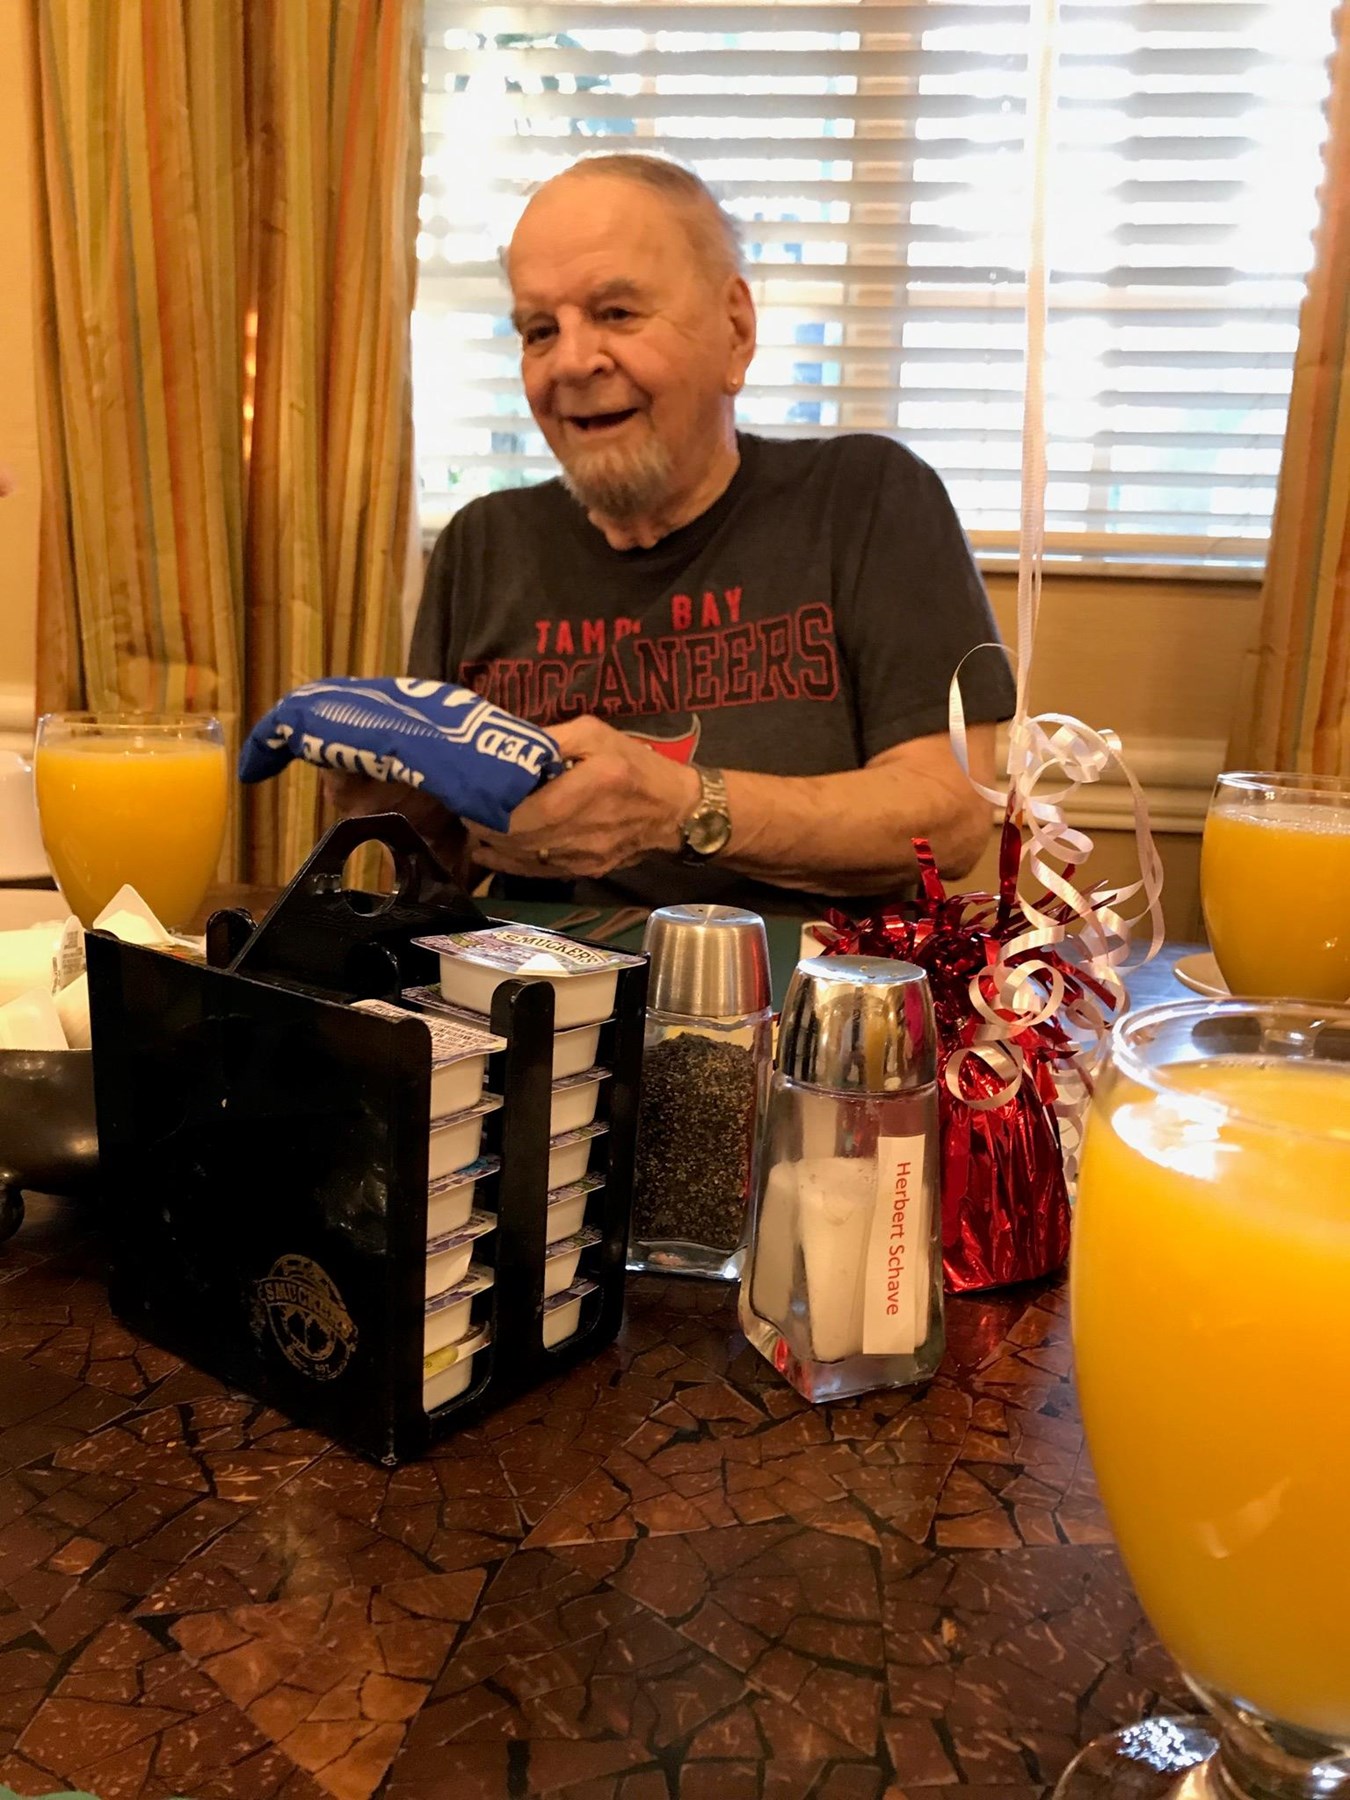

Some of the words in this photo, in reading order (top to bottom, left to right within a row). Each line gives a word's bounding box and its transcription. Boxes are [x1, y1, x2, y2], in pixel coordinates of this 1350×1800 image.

[534, 617, 642, 655] TAMP
[671, 586, 743, 632] BAY
[889, 1162, 911, 1239] Herbert
[886, 1244, 905, 1315] Schave
